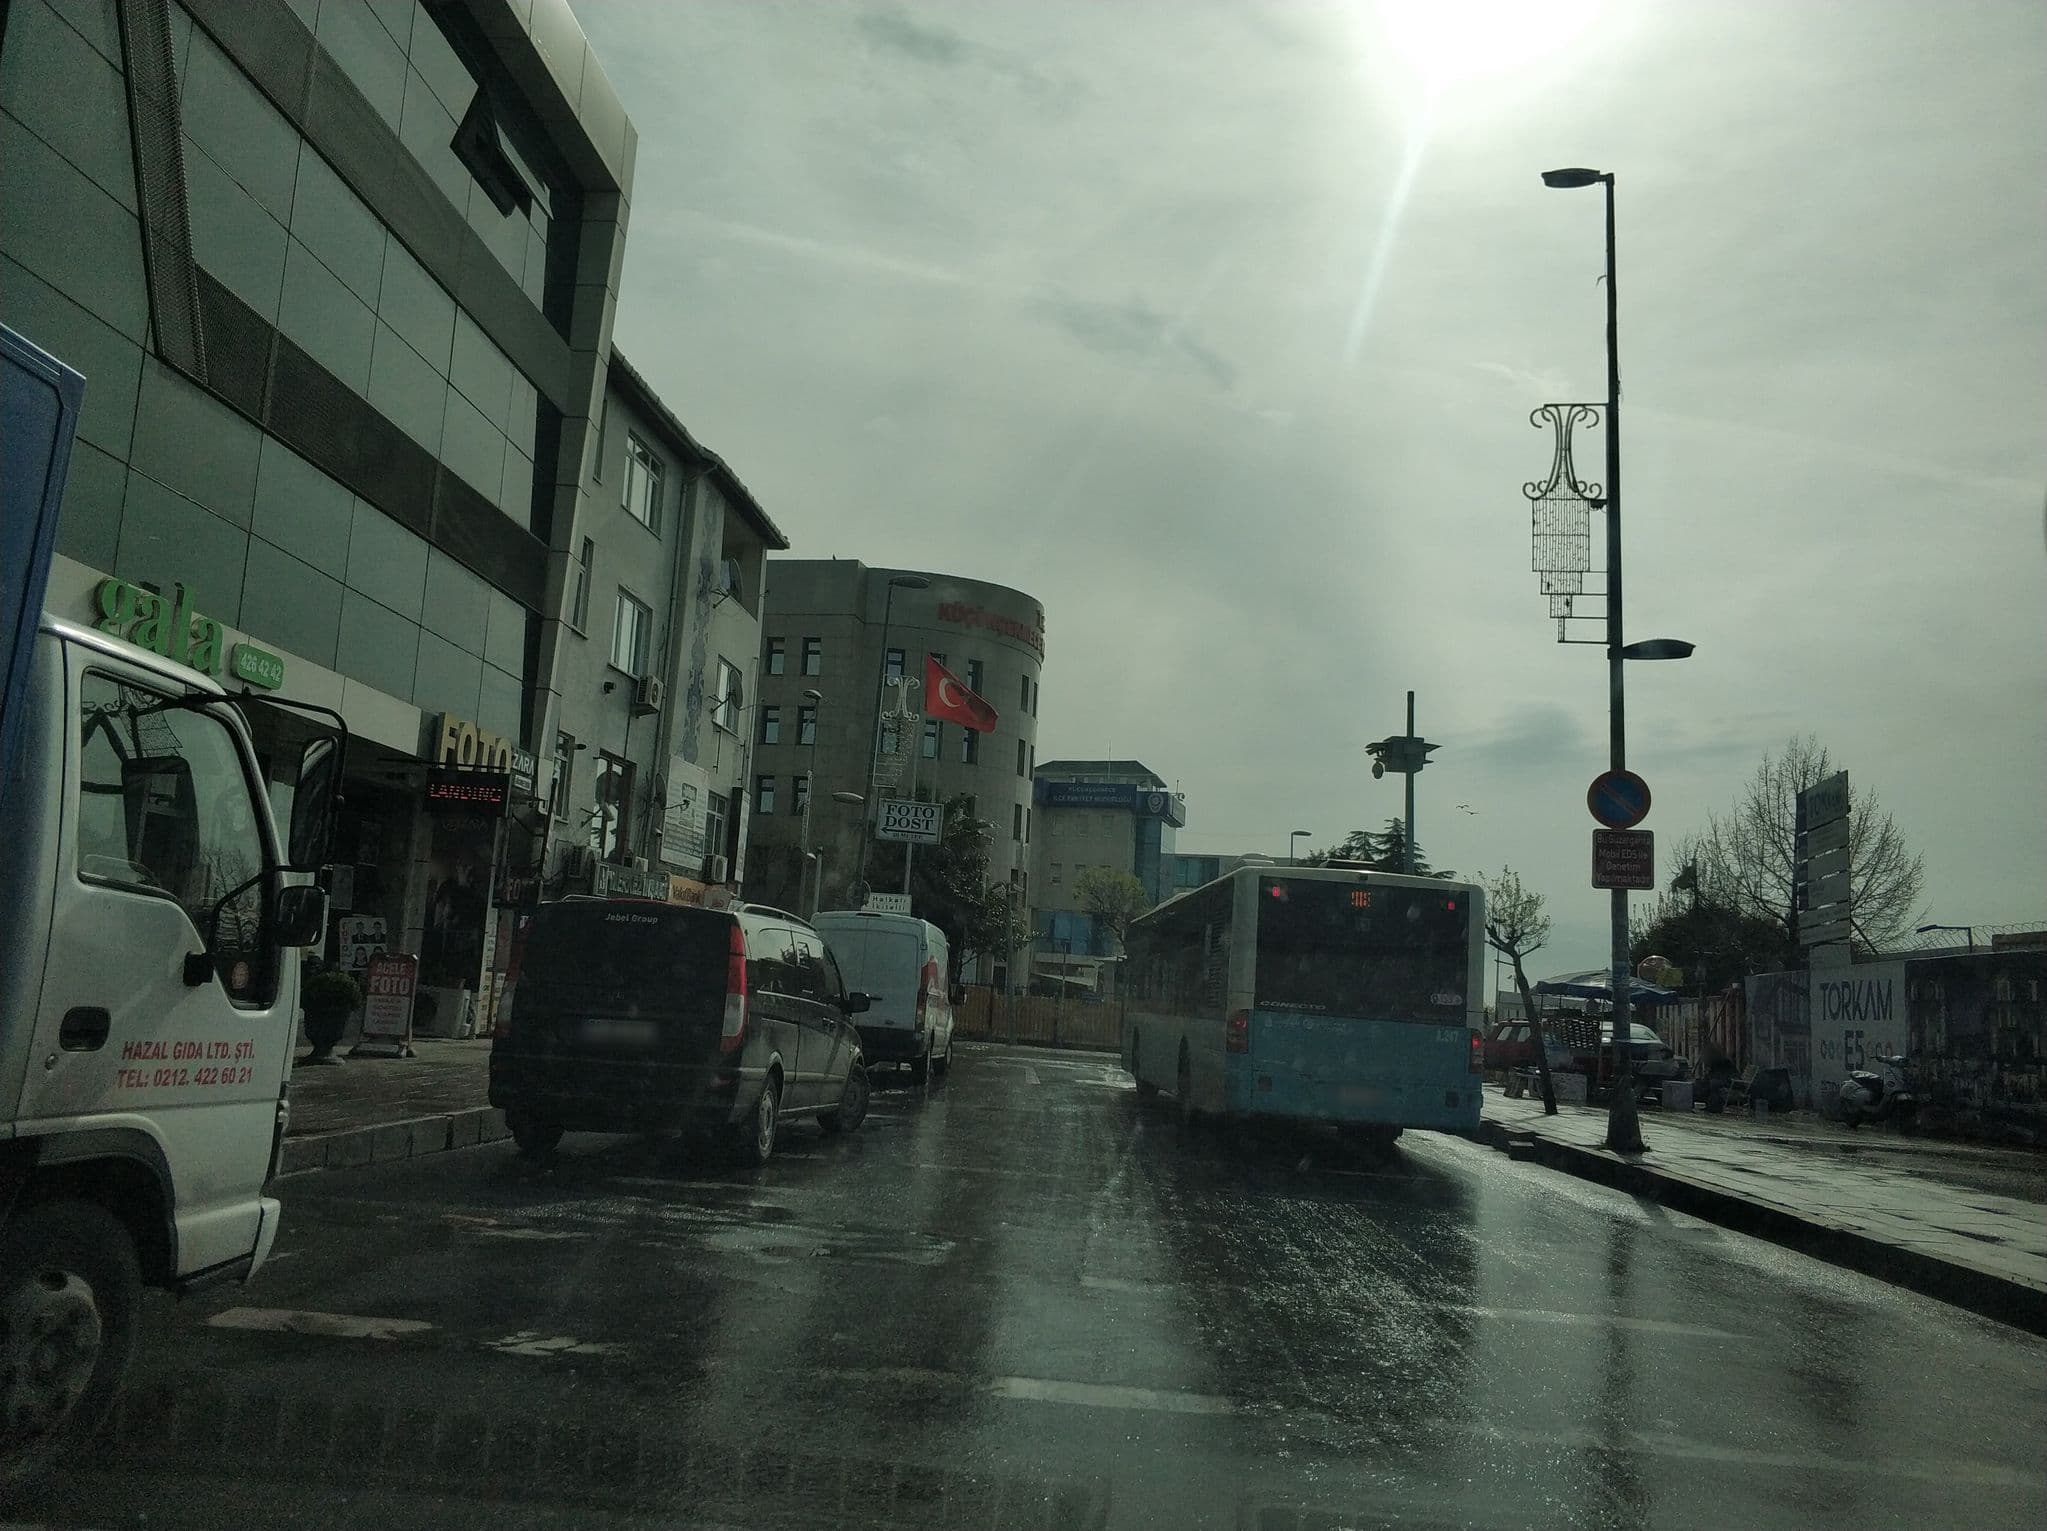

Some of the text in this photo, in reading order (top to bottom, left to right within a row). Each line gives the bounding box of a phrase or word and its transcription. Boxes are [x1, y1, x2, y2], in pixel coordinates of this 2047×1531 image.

[99, 577, 222, 677] gala
[439, 712, 512, 774] FOTO
[512, 753, 535, 776] ZARA
[886, 804, 934, 819] FOTO
[884, 816, 934, 831] DOST
[605, 913, 658, 925] Jebel Group
[369, 975, 410, 994] FOTO
[1260, 1000, 1326, 1010] CONECTO
[1819, 979, 1893, 1021] TORKAM
[122, 1039, 255, 1063] HAZAL GIDA LTD. ŞTİ.
[118, 1068, 148, 1088] TEL:
[194, 1067, 218, 1086] 422
[221, 1067, 236, 1084] 60
[239, 1066, 253, 1083] 21
